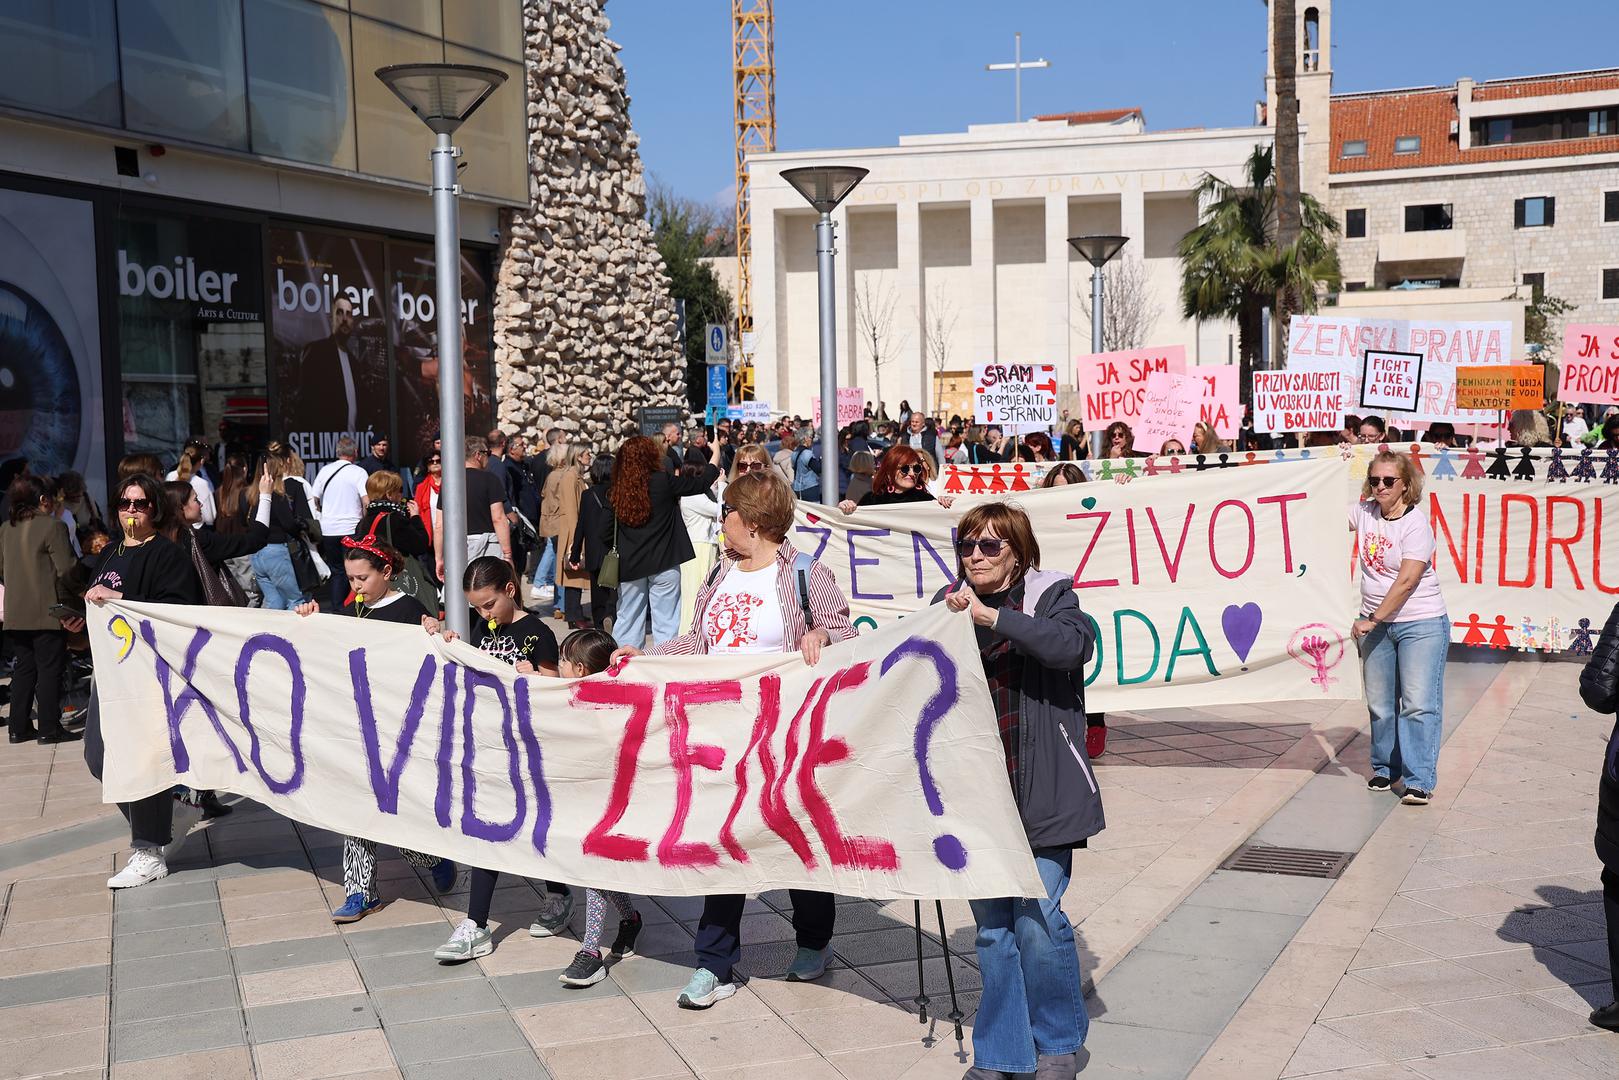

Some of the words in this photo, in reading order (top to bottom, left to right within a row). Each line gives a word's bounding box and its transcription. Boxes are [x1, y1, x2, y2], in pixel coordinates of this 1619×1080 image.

[966, 180, 1004, 197] OD
[118, 249, 238, 304] boiler
[1408, 329, 1502, 362] PRAVA
[1578, 334, 1600, 358] JA
[1096, 362, 1120, 385] JA
[1129, 357, 1168, 382] SAM
[1373, 358, 1411, 372] FIGHT
[981, 364, 1034, 387] SRAM
[1254, 373, 1292, 393] PRIZIV
[1375, 372, 1403, 385] LIKE
[1519, 379, 1542, 387] UBIJA
[1564, 364, 1619, 394] PROM
[1000, 384, 1030, 394] MORA
[1369, 384, 1378, 395] A
[1383, 385, 1410, 399] GIRL
[1505, 388, 1515, 397] NE
[1519, 389, 1539, 397] VODI
[980, 394, 1044, 408] PROMIJENITI
[1087, 387, 1146, 421] NEPOS
[1258, 394, 1266, 411] U
[1314, 394, 1322, 410] A
[1327, 394, 1342, 411] NE
[1000, 407, 1052, 422] STRANU
[1266, 414, 1275, 430] U
[1284, 411, 1336, 429] BOLNICU
[349, 647, 552, 858] VIDI
